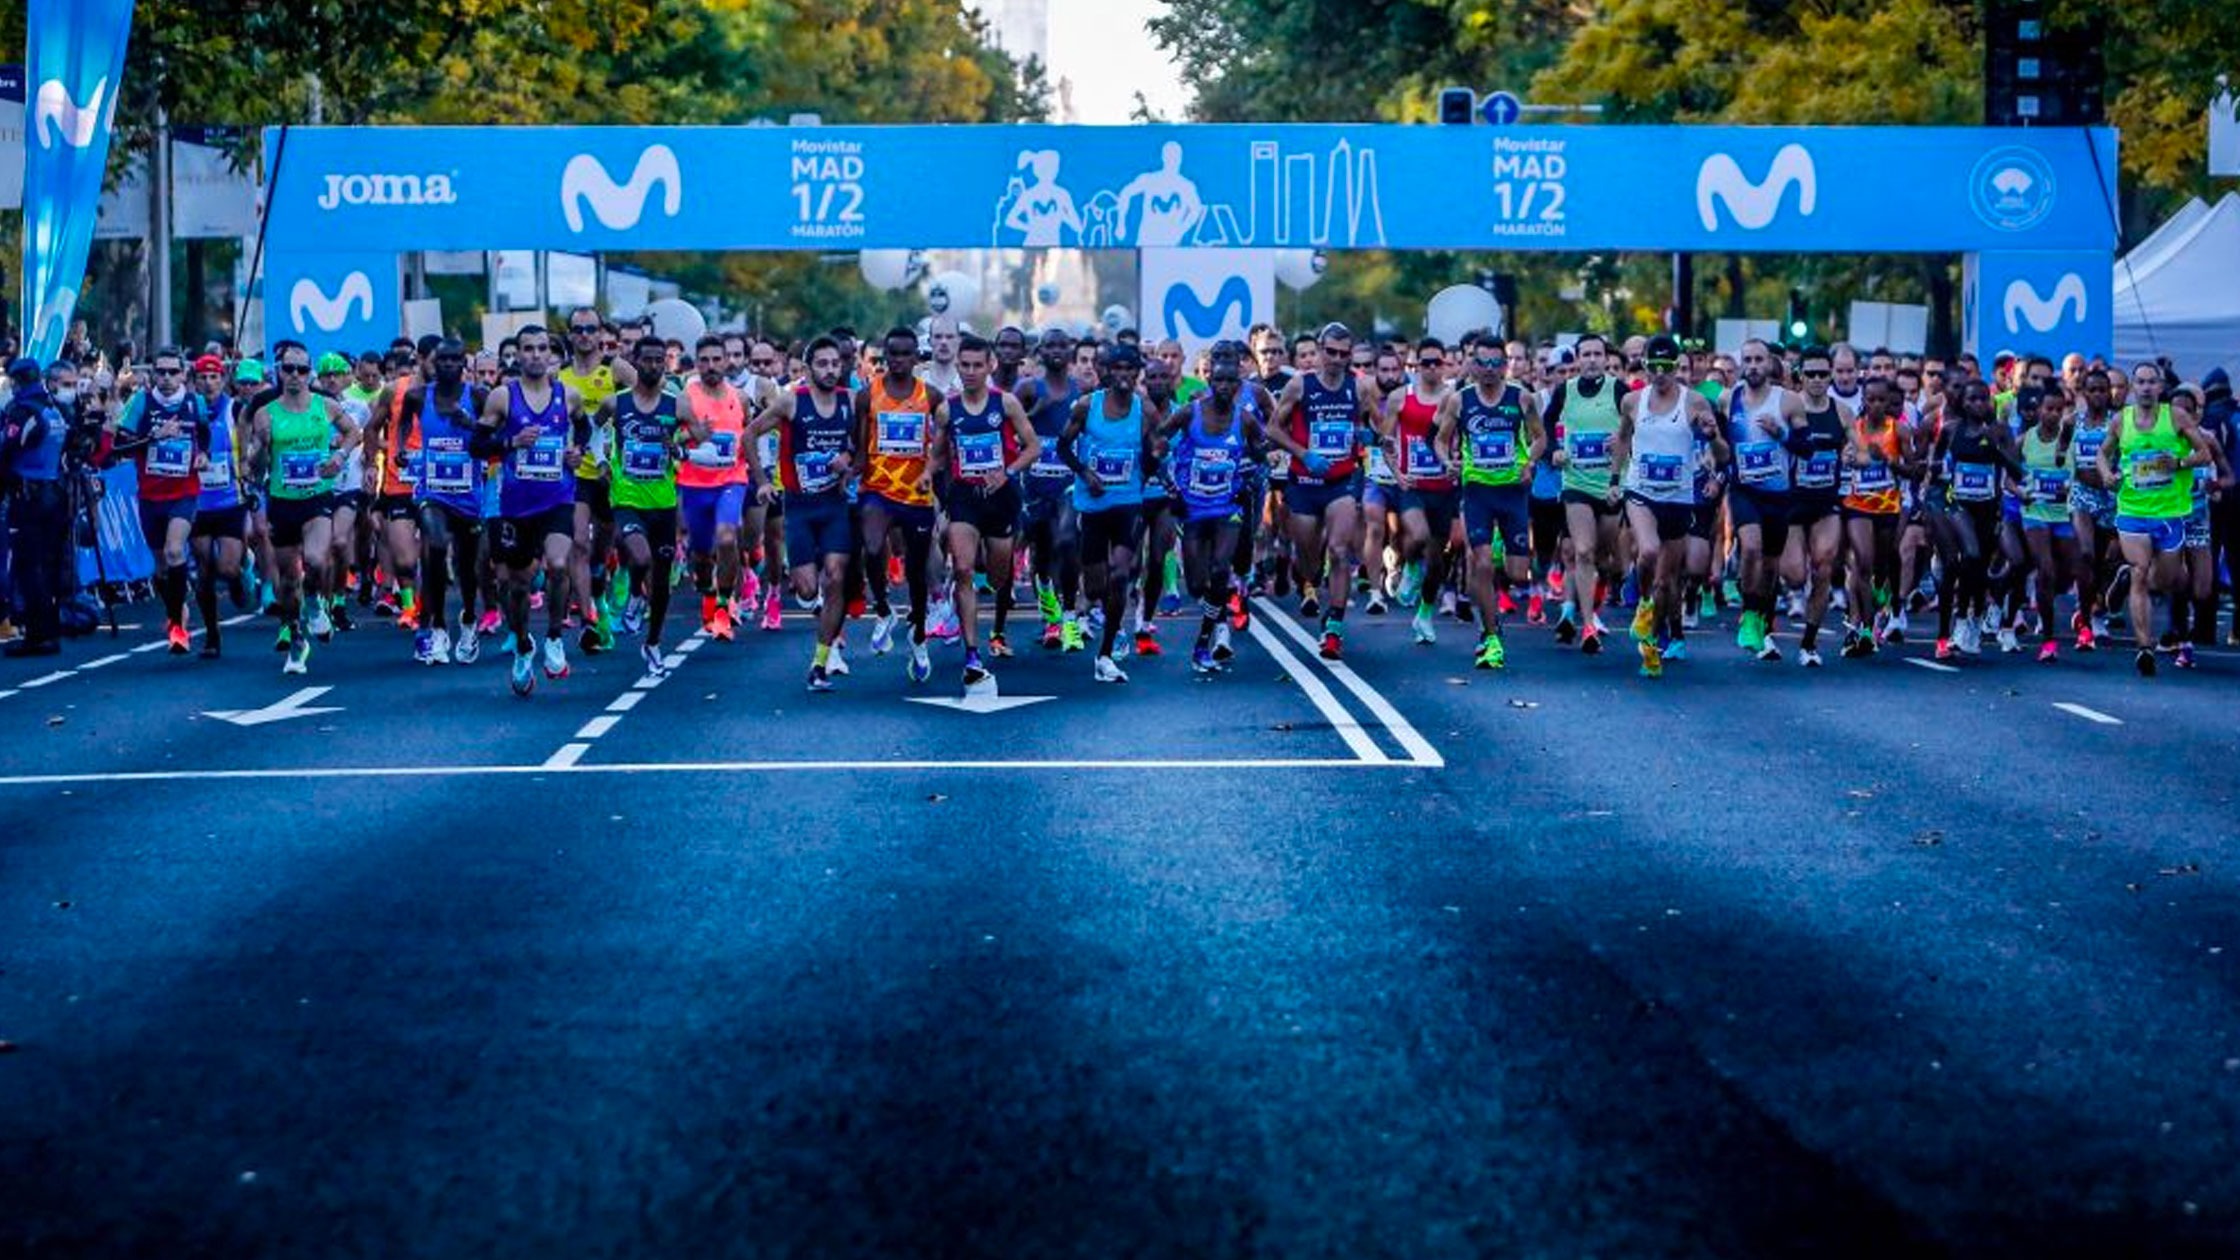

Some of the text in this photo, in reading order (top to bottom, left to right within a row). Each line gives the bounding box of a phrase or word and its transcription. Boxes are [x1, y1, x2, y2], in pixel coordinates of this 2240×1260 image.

[791, 139, 863, 154] Movistar
[1493, 137, 1566, 152] Movistar
[791, 156, 865, 181] MAD
[1493, 154, 1567, 180] MAD
[791, 182, 865, 222] 1/2
[1493, 181, 1566, 220] 1/2
[790, 223, 865, 238] MARATÓN
[1492, 221, 1567, 236] MARATÓN
